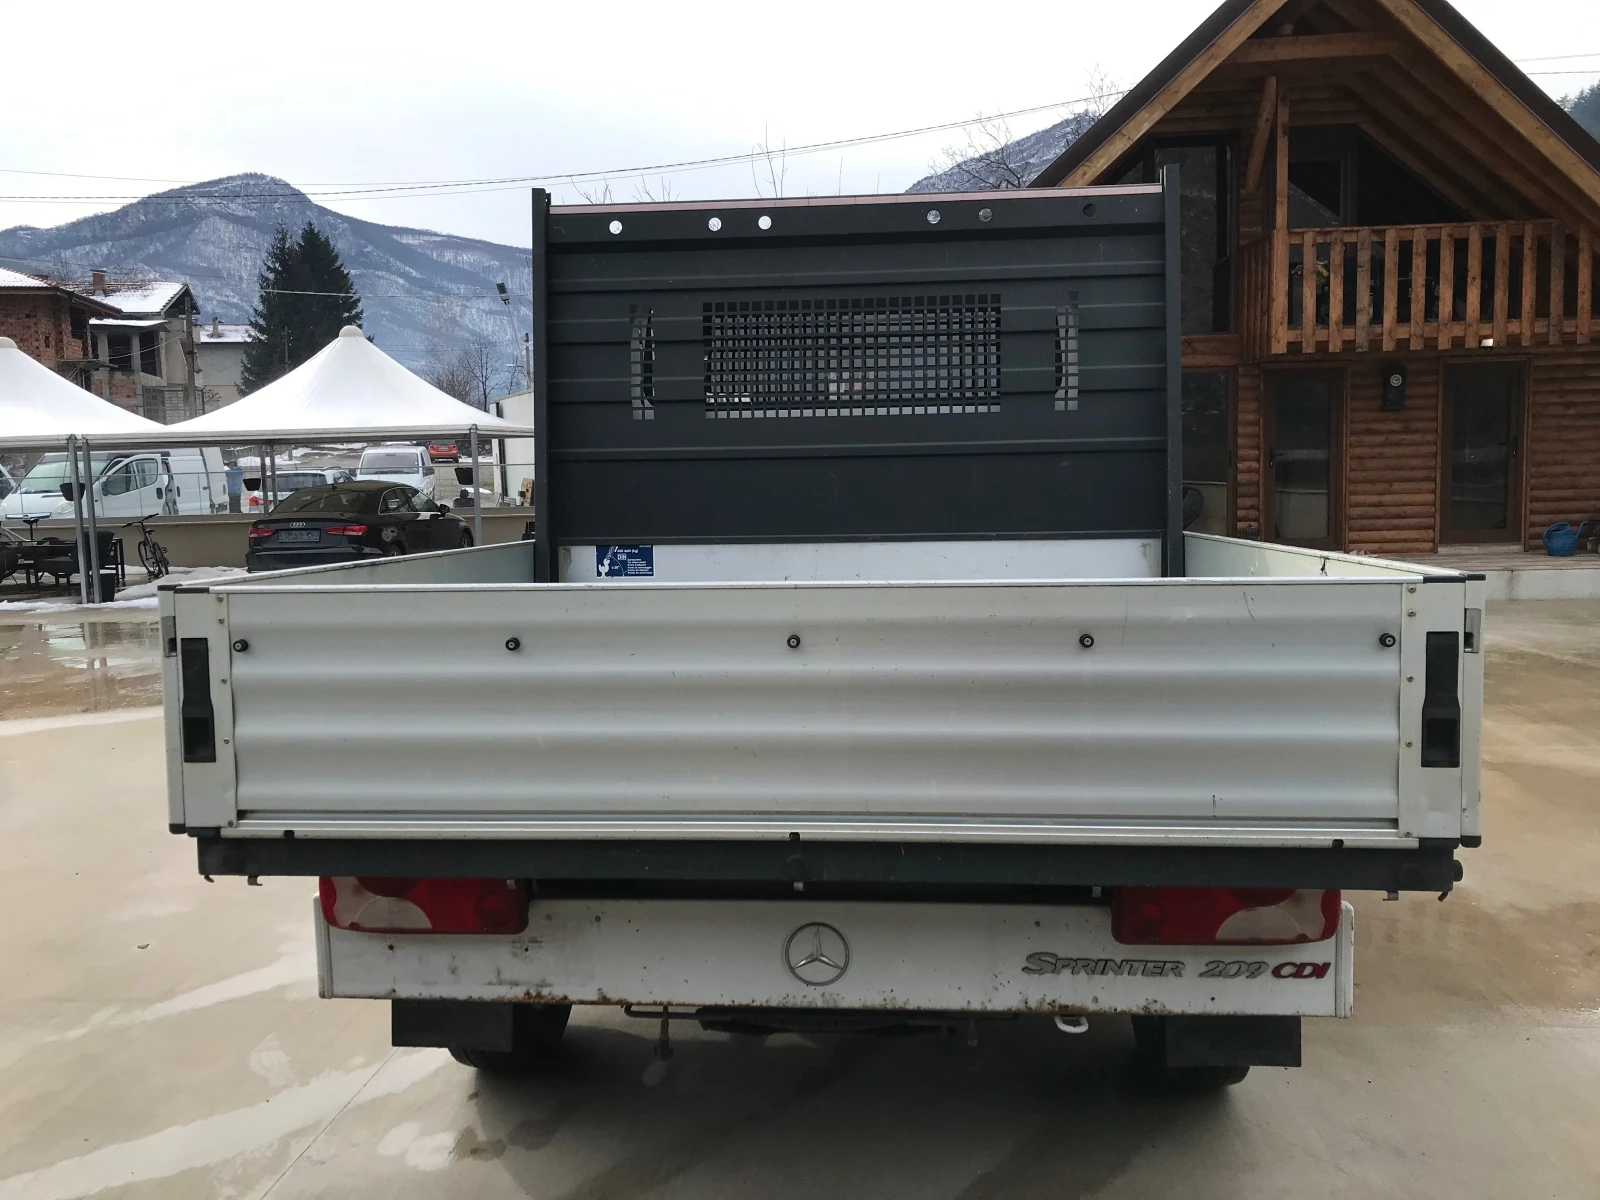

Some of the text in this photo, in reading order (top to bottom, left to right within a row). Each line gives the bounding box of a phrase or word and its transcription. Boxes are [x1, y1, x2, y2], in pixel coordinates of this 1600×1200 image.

[1021, 951, 1332, 980] SPRINTER 209 CDI
